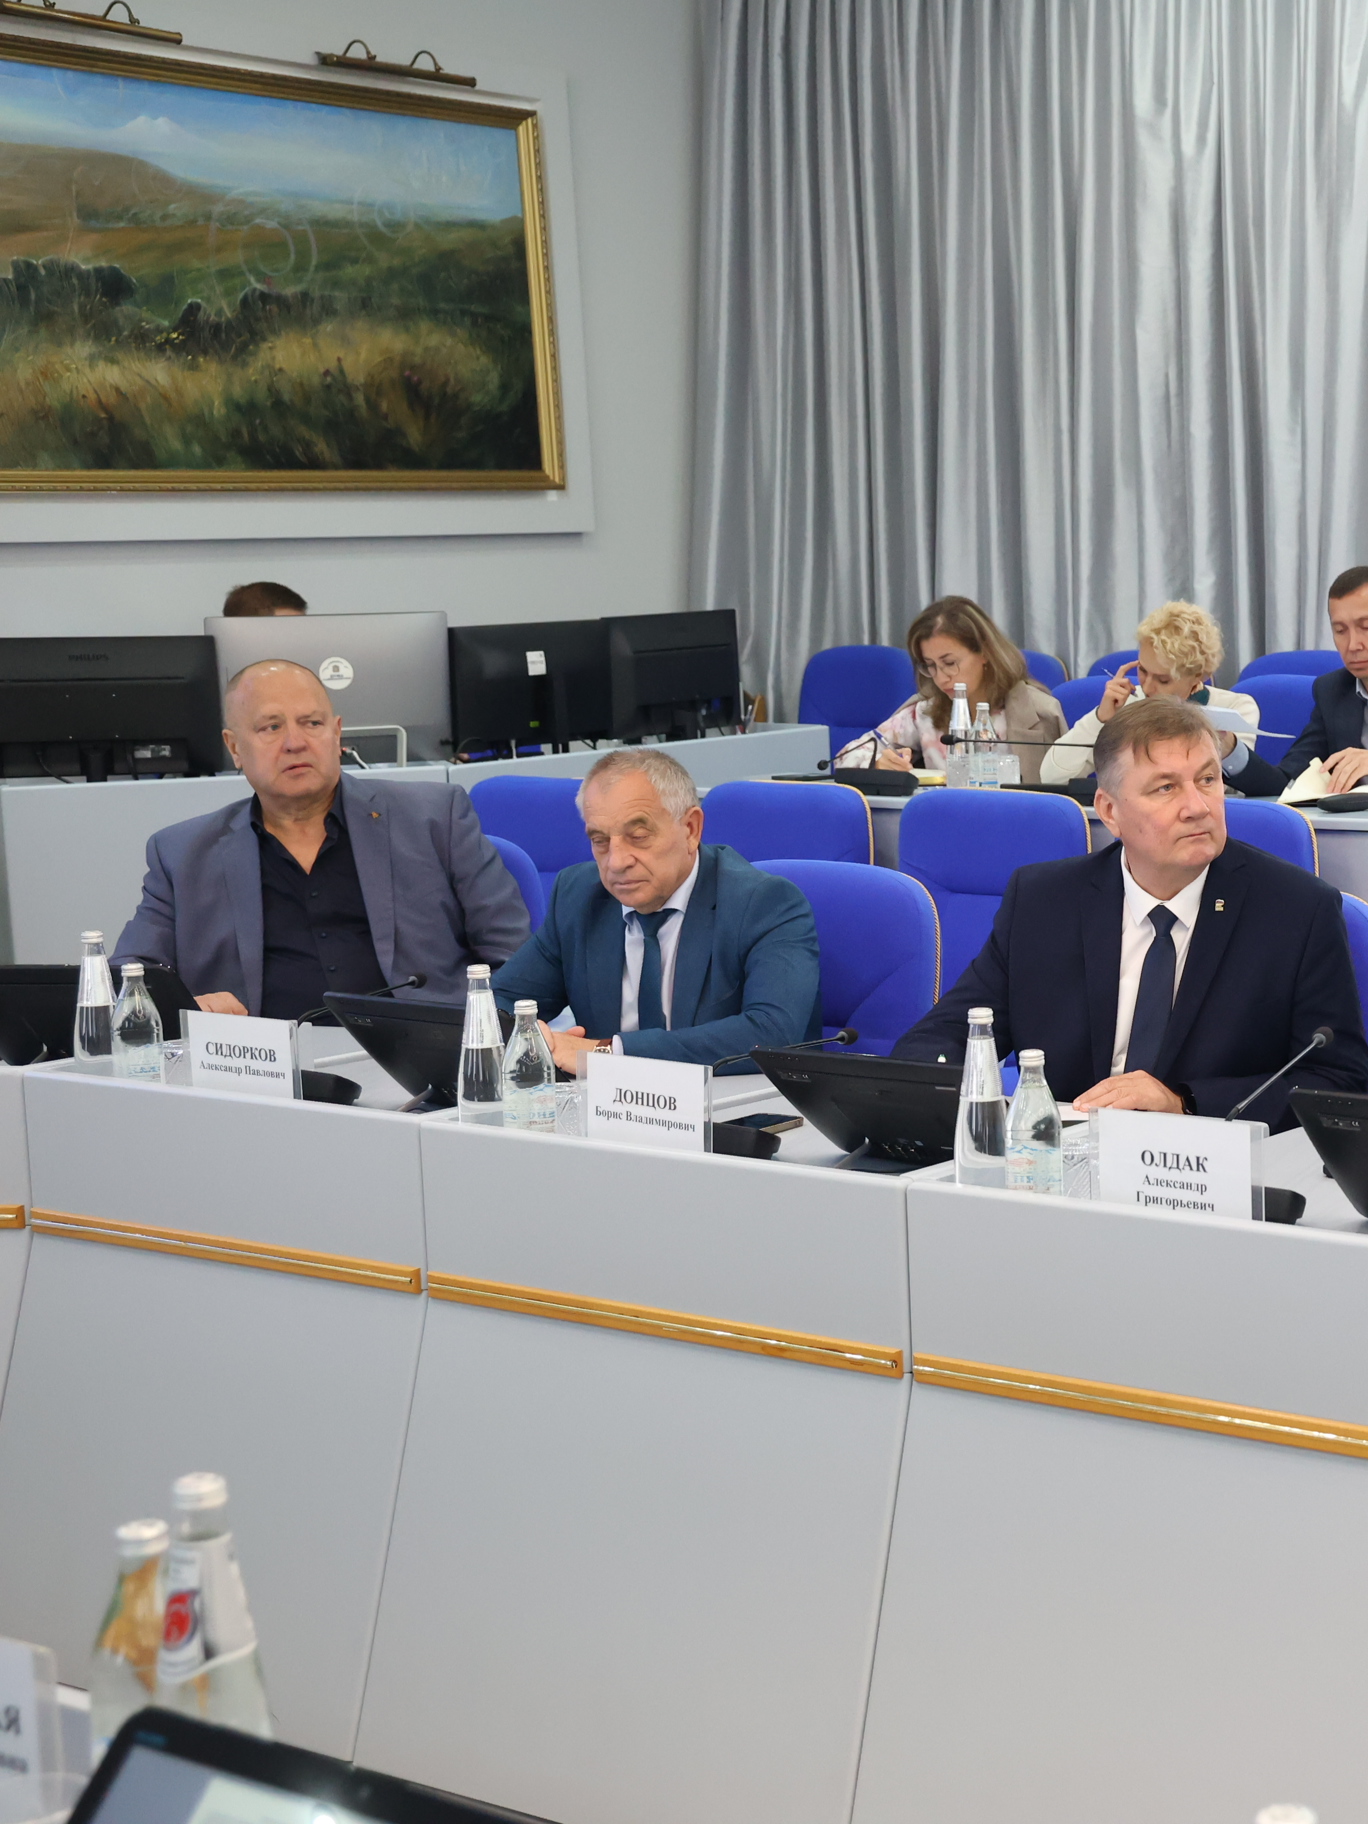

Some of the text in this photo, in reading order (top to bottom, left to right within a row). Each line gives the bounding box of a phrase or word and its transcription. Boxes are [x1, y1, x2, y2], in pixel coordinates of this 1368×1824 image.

[205, 1041, 277, 1063] СИДОРКОВ
[199, 1060, 286, 1080] Александр Павлович
[613, 1087, 677, 1111] ДОНЦОВ
[595, 1105, 696, 1132] Борис Владимирович
[1140, 1149, 1209, 1174] ОЛДАК
[1142, 1174, 1208, 1195] Александр
[1136, 1190, 1215, 1212] Григорьевич
